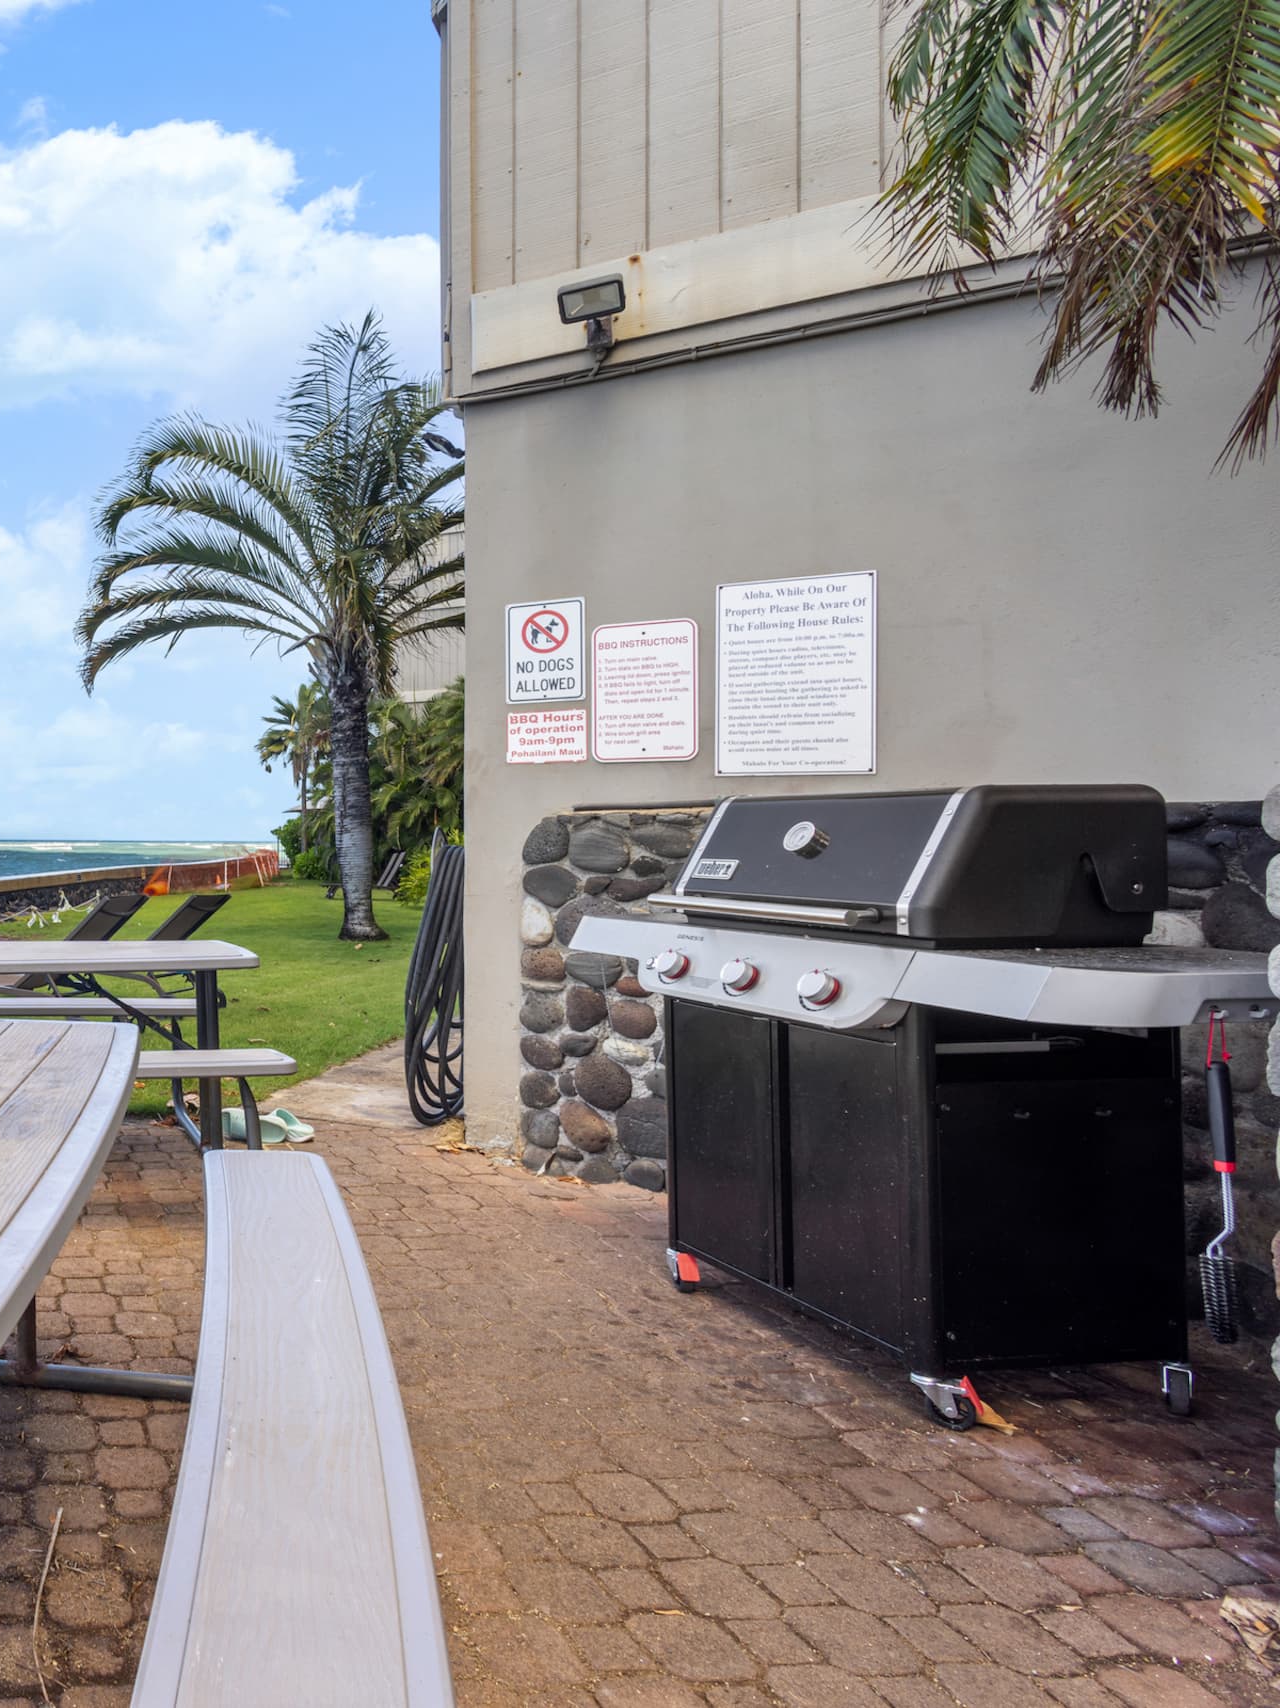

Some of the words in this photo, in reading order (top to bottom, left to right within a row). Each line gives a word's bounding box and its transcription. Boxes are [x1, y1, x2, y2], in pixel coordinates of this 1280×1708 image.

[776, 587, 805, 597] While
[808, 586, 823, 594] On
[826, 584, 847, 592] Our
[725, 607, 766, 618] Property
[770, 604, 800, 614] Please
[803, 602, 815, 611] Be
[817, 601, 850, 610] Aware
[852, 597, 866, 607] Of
[727, 623, 745, 632] The
[747, 620, 795, 631] Following
[798, 618, 828, 627] House
[832, 615, 863, 625] Rules:
[598, 641, 618, 650] BBQ
[620, 636, 688, 648] INSTRUCTIONS
[516, 661, 534, 674] NO
[538, 657, 574, 672] DOGS
[516, 677, 575, 693] ALLOWED
[509, 714, 539, 724] BBQ
[543, 713, 584, 722] Hours
[510, 727, 521, 735] of
[525, 724, 584, 735] operation
[519, 736, 575, 746] 9am-9pm
[559, 748, 583, 756] Maui
[697, 861, 725, 876] weber
